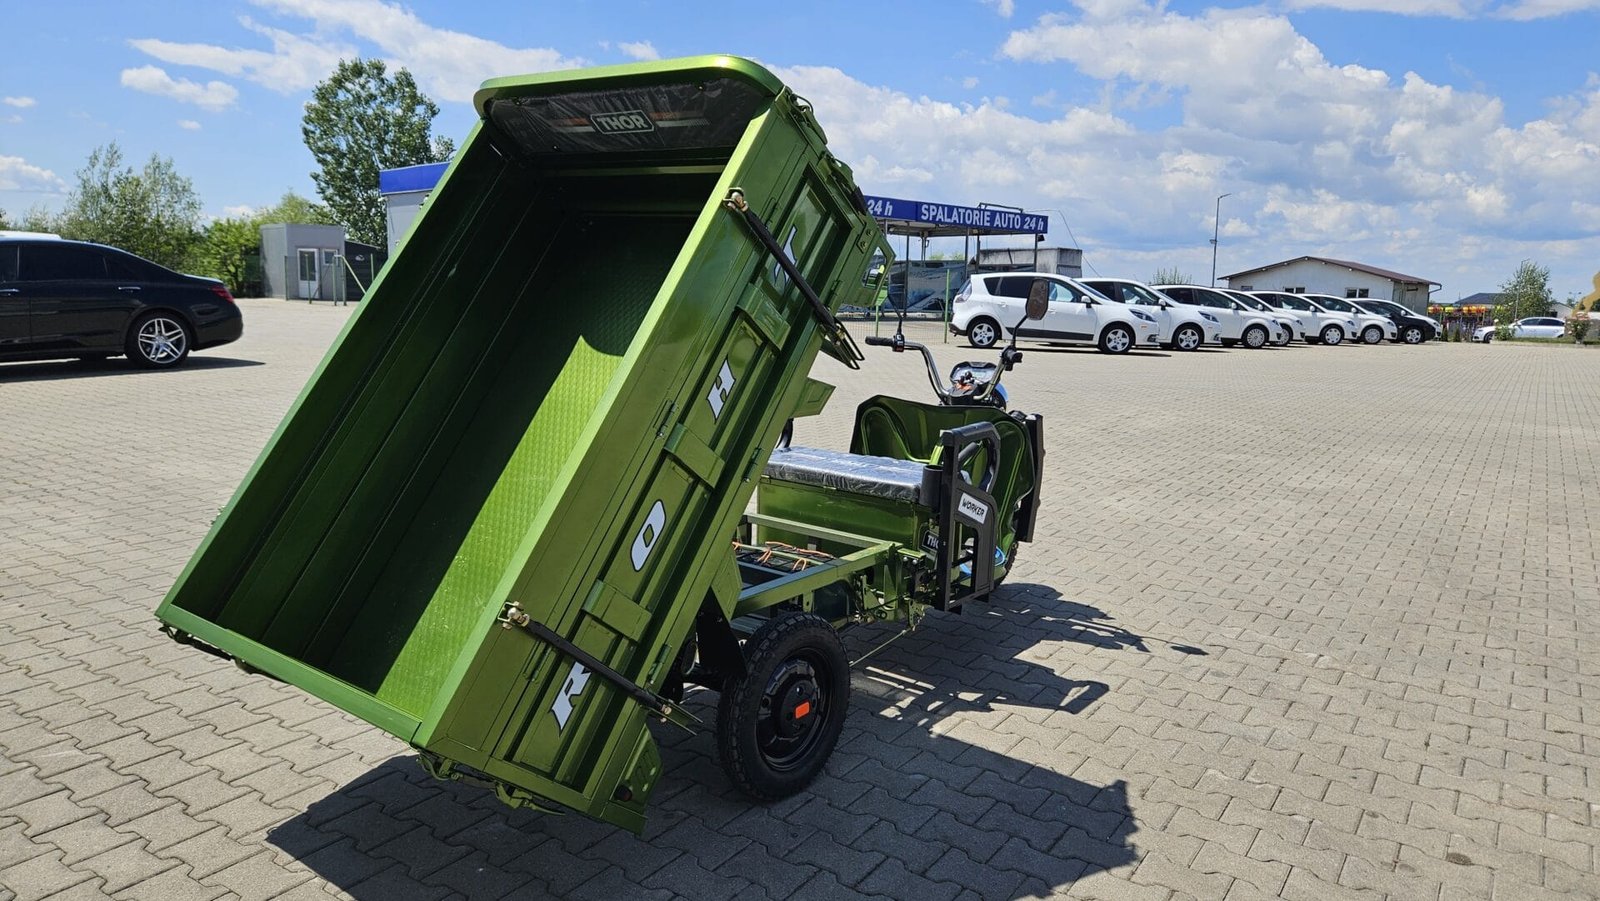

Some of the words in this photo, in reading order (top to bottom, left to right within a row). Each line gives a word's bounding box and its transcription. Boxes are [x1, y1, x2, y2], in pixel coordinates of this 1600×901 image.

[597, 113, 649, 133] THOR
[867, 199, 882, 215] 24
[884, 201, 893, 216] h
[921, 204, 991, 227] SPALATORIE
[993, 212, 1021, 229] AUTO
[1023, 217, 1037, 231] 24
[1037, 218, 1044, 231] h
[962, 499, 985, 517] WORKER
